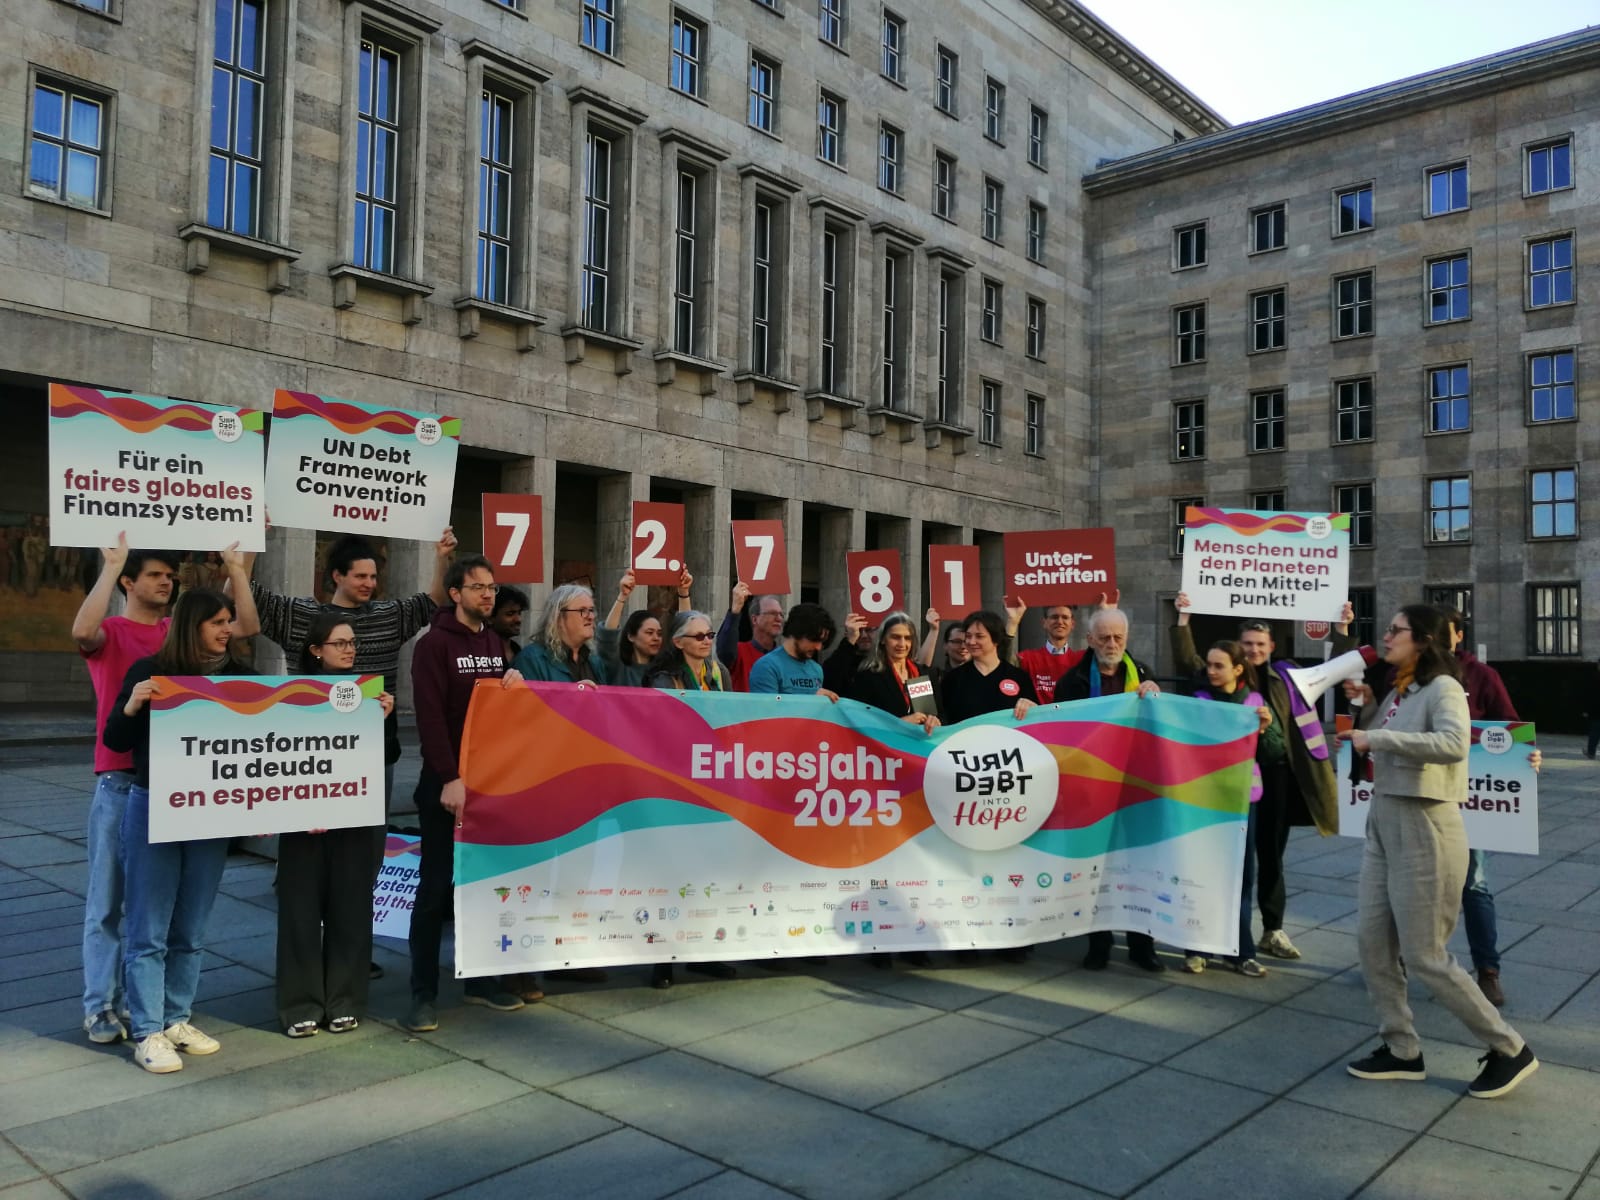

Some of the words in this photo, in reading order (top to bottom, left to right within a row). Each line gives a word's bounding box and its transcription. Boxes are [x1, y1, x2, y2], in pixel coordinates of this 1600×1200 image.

[118, 449, 160, 472] Für
[166, 454, 203, 475] ein
[323, 438, 355, 458] UN
[359, 443, 411, 465] Debt
[64, 468, 143, 494] faires
[146, 473, 253, 502] globales
[298, 456, 428, 488] Framework
[296, 476, 427, 507] Convention
[63, 494, 253, 525] Finanzsystem!
[333, 504, 388, 523] now!
[496, 513, 530, 566] 7
[635, 520, 681, 571] 2.
[1194, 539, 1294, 558] Menschen
[1300, 544, 1338, 559] und
[745, 535, 775, 580] 7
[1025, 552, 1093, 568] Unter-
[1200, 557, 1236, 572] den
[1242, 558, 1330, 576] Planeten
[858, 565, 894, 613] 8
[943, 560, 965, 606] 1
[1014, 567, 1107, 586] schriften
[1199, 571, 1216, 586] in
[1221, 573, 1257, 589] den
[1262, 576, 1330, 592] Mittel-
[1230, 591, 1295, 609] punkt!
[1306, 622, 1328, 633] STOP
[181, 732, 360, 756] Transformar
[212, 760, 238, 781] la
[245, 755, 332, 779] deuda
[691, 742, 903, 792] Erlassjahr
[168, 790, 206, 808] en
[212, 776, 368, 810] esperanza!
[982, 797, 1010, 806] INTO
[793, 788, 902, 828] 2025
[953, 801, 1028, 831] Hope
[390, 896, 415, 910] the
